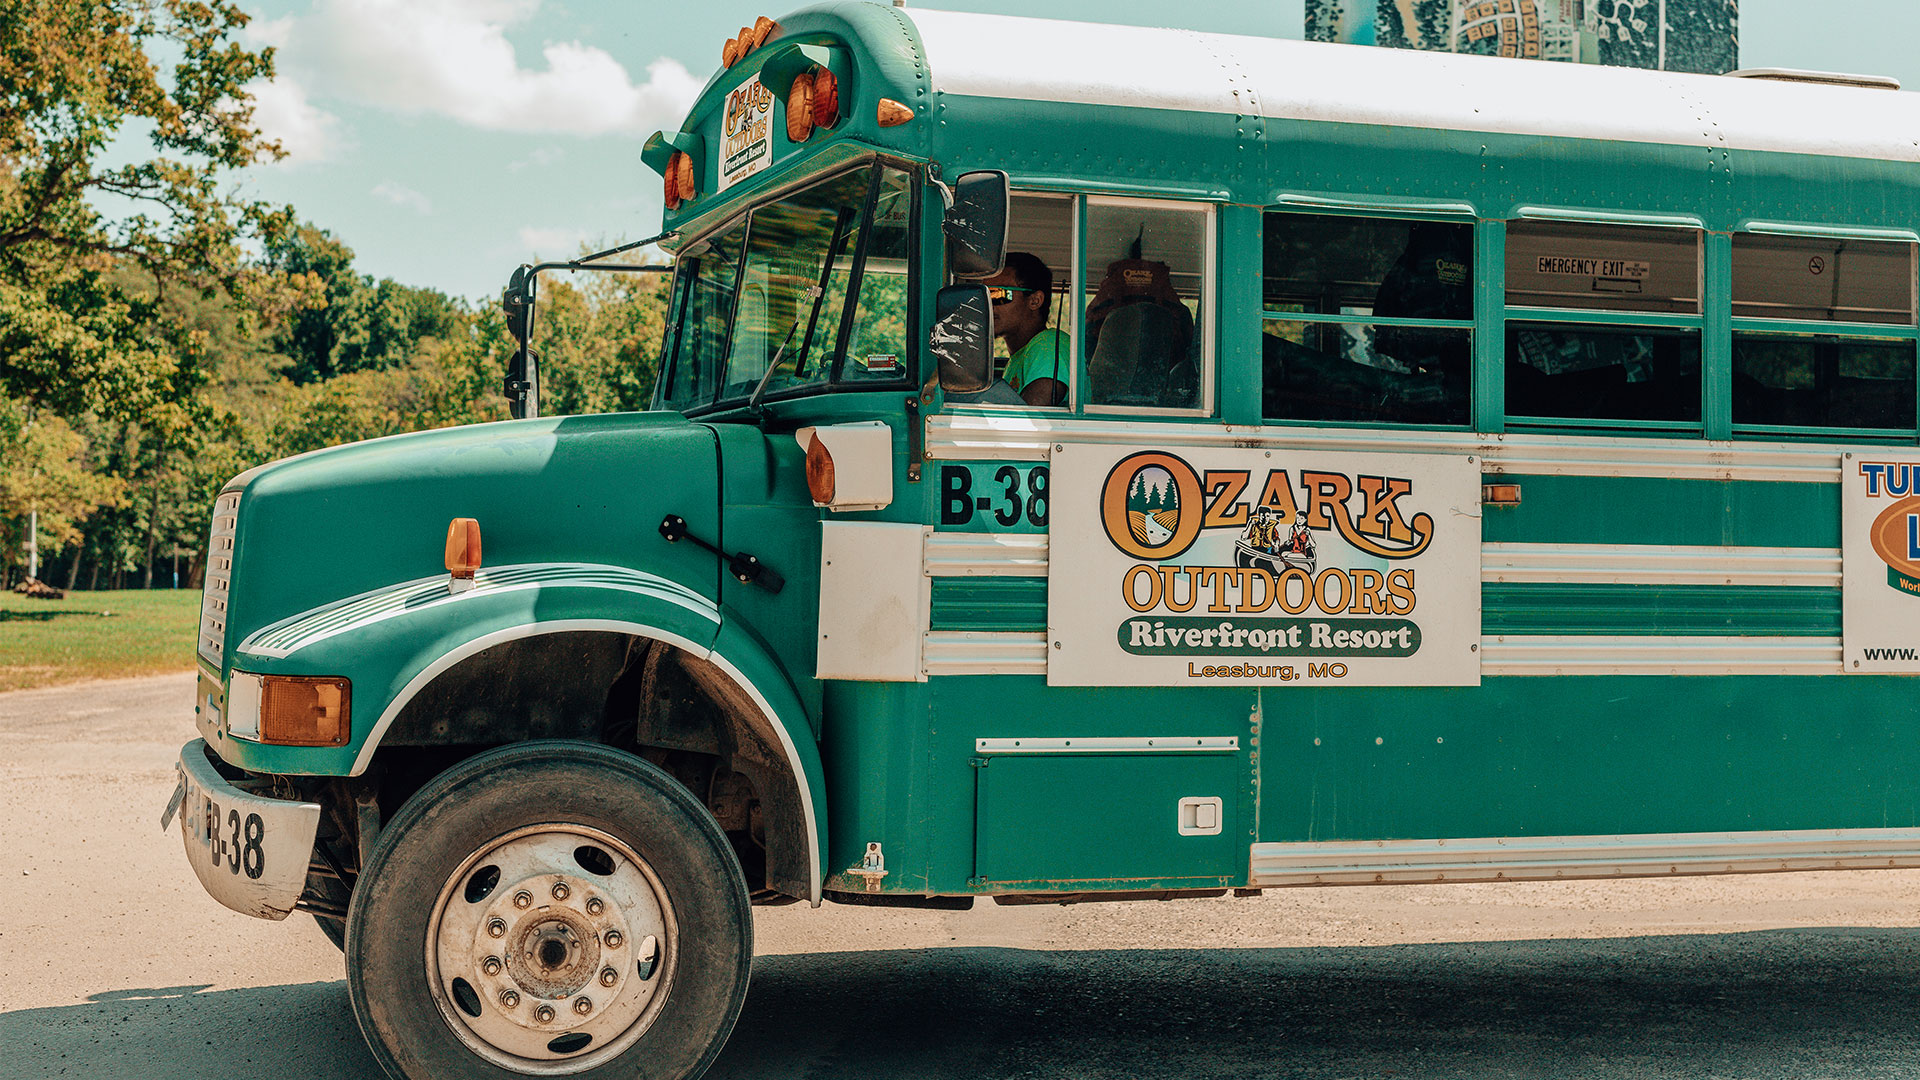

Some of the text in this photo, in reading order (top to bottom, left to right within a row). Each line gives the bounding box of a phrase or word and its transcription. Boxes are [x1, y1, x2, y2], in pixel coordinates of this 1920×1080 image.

[1436, 259, 1468, 274] OZARK
[1538, 257, 1598, 275] EMERGENCY
[1602, 260, 1625, 277] EXIT
[941, 465, 1050, 527] B-38
[1100, 450, 1435, 561] OZARK
[1122, 564, 1417, 616] OUTDOORS
[1128, 621, 1412, 649] Riverfront Resort
[1187, 662, 1349, 682] Leasburg, MO
[211, 801, 265, 880] B-38
